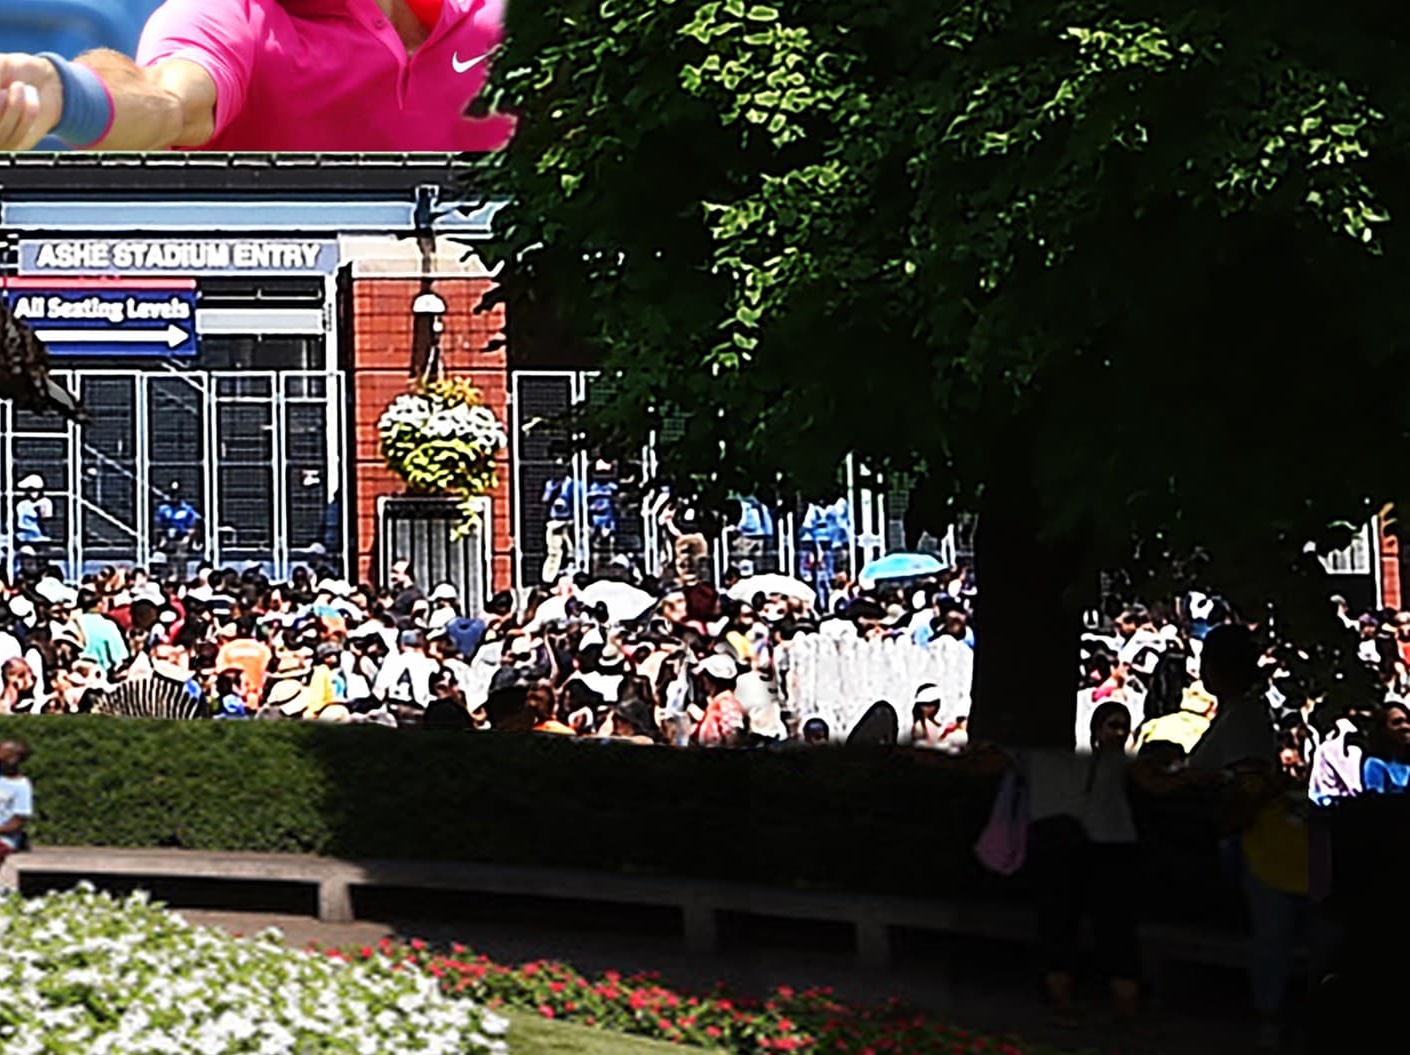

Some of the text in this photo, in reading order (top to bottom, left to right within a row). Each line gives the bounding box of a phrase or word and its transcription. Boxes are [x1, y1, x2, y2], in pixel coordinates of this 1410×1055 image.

[36, 243, 320, 268] ASHE STADIUM ENTRY
[14, 297, 190, 322] All Seating Levels
